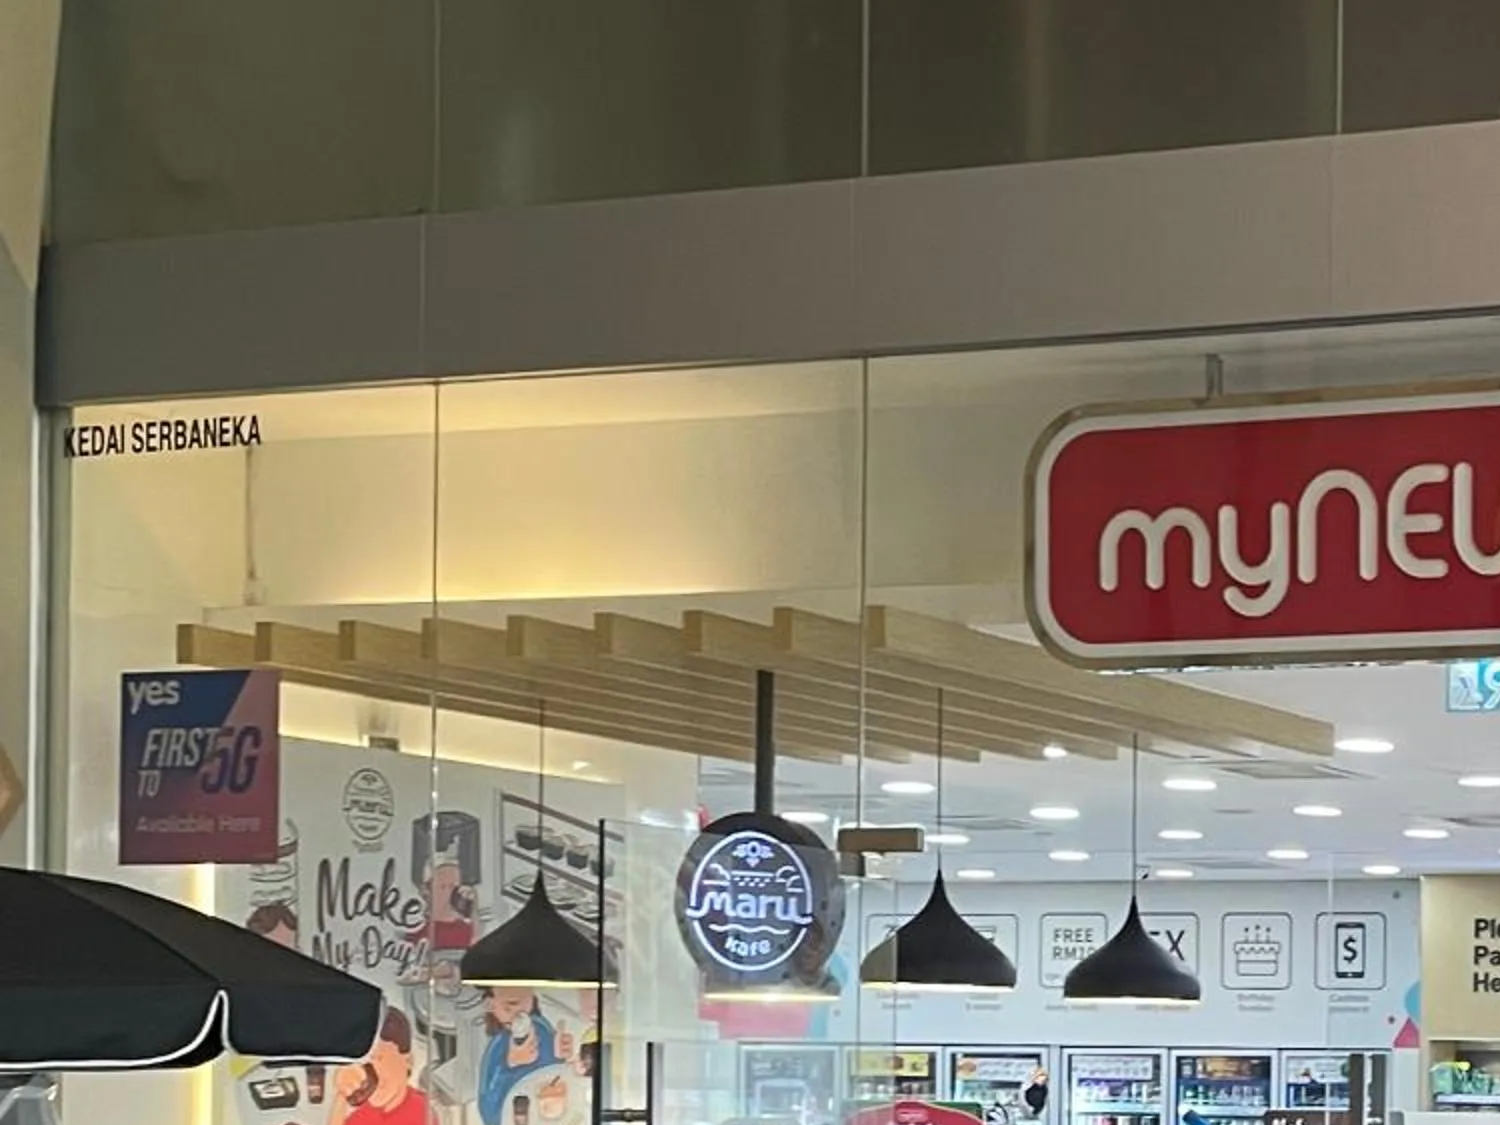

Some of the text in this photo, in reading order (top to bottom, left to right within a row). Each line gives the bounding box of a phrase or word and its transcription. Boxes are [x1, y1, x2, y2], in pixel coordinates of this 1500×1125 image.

[64, 415, 261, 457] KEDAI SERBANEKA
[128, 679, 181, 714] yes
[141, 725, 263, 794] FIRST 5G
[138, 770, 161, 798] TO
[136, 813, 261, 834] Available Here
[317, 857, 425, 932] Make
[1053, 928, 1095, 943] FREE
